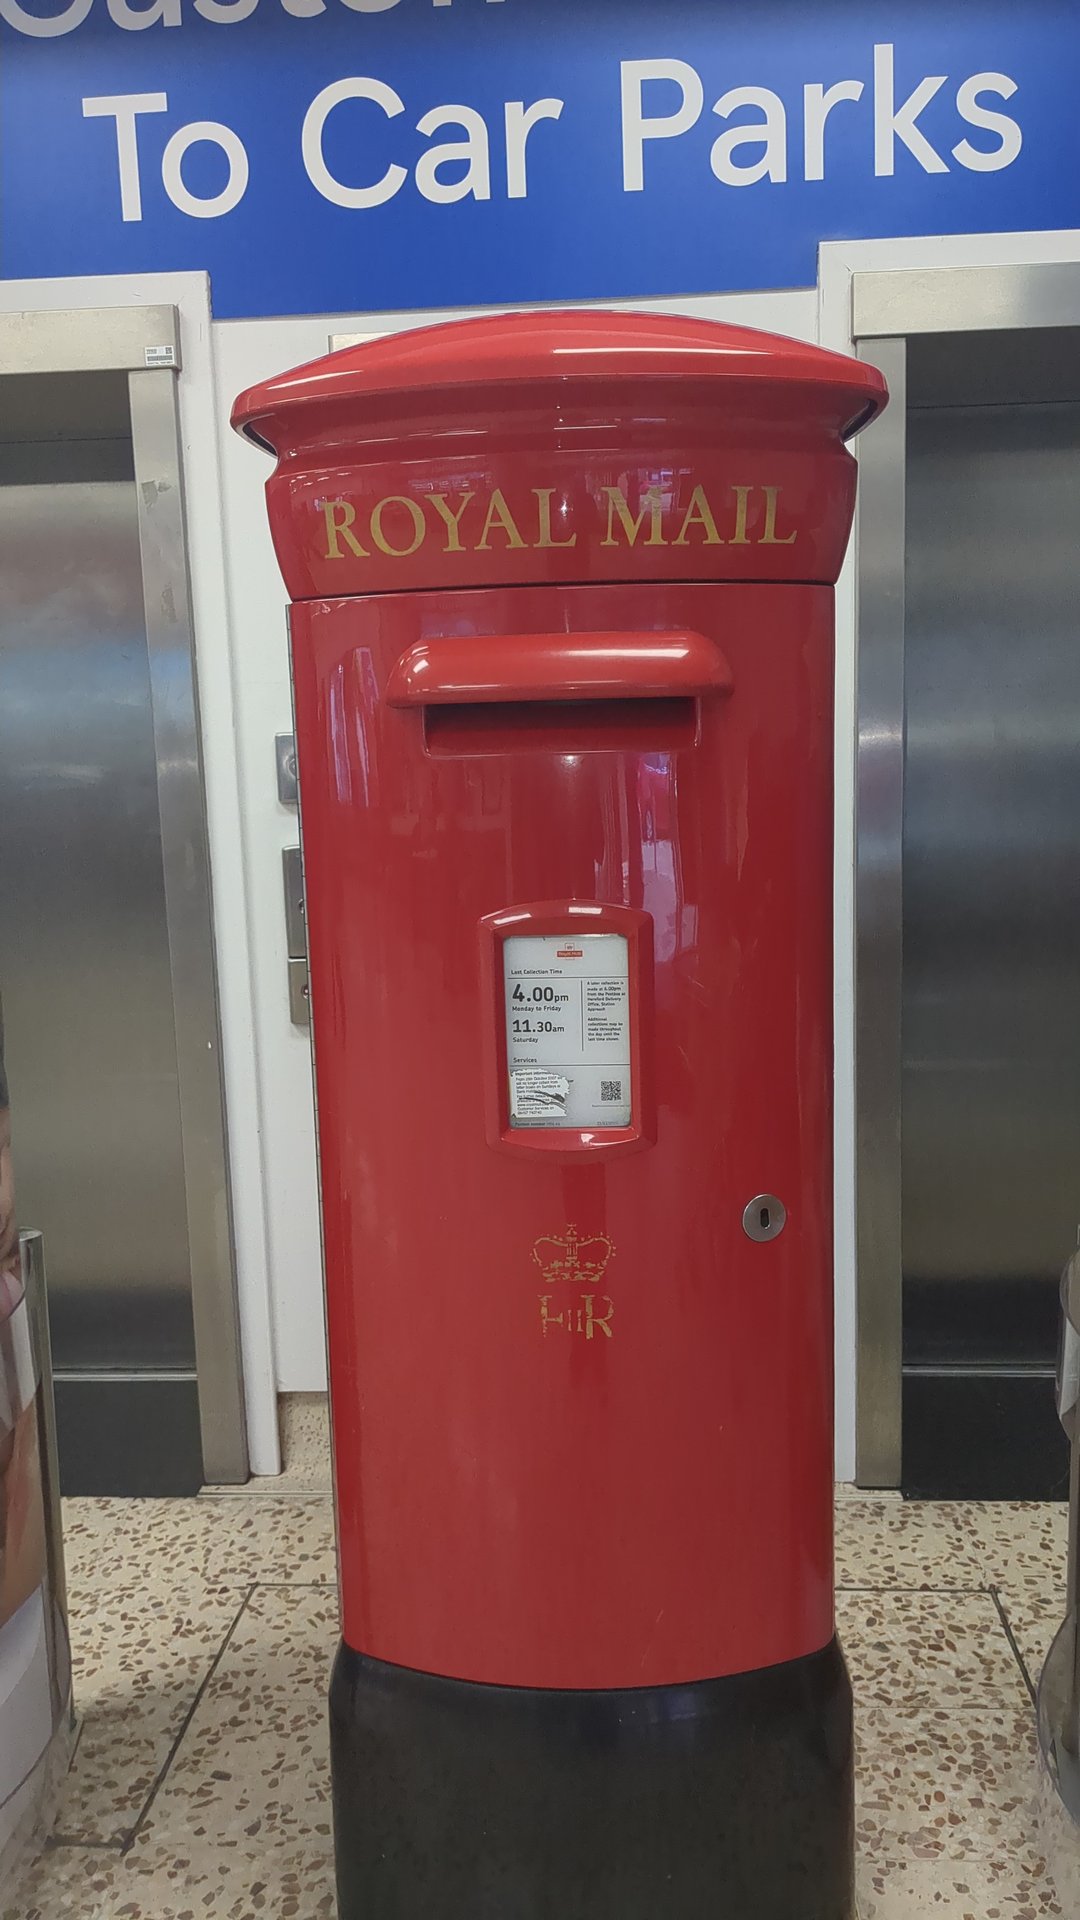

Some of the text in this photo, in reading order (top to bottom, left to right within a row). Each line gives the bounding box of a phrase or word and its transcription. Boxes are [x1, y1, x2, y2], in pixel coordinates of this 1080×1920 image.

[82, 43, 1022, 222] To Car Parks
[320, 484, 798, 559] ROYAL MAIL
[512, 983, 569, 1003] 4.00pm
[512, 1019, 565, 1033] 11.30am
